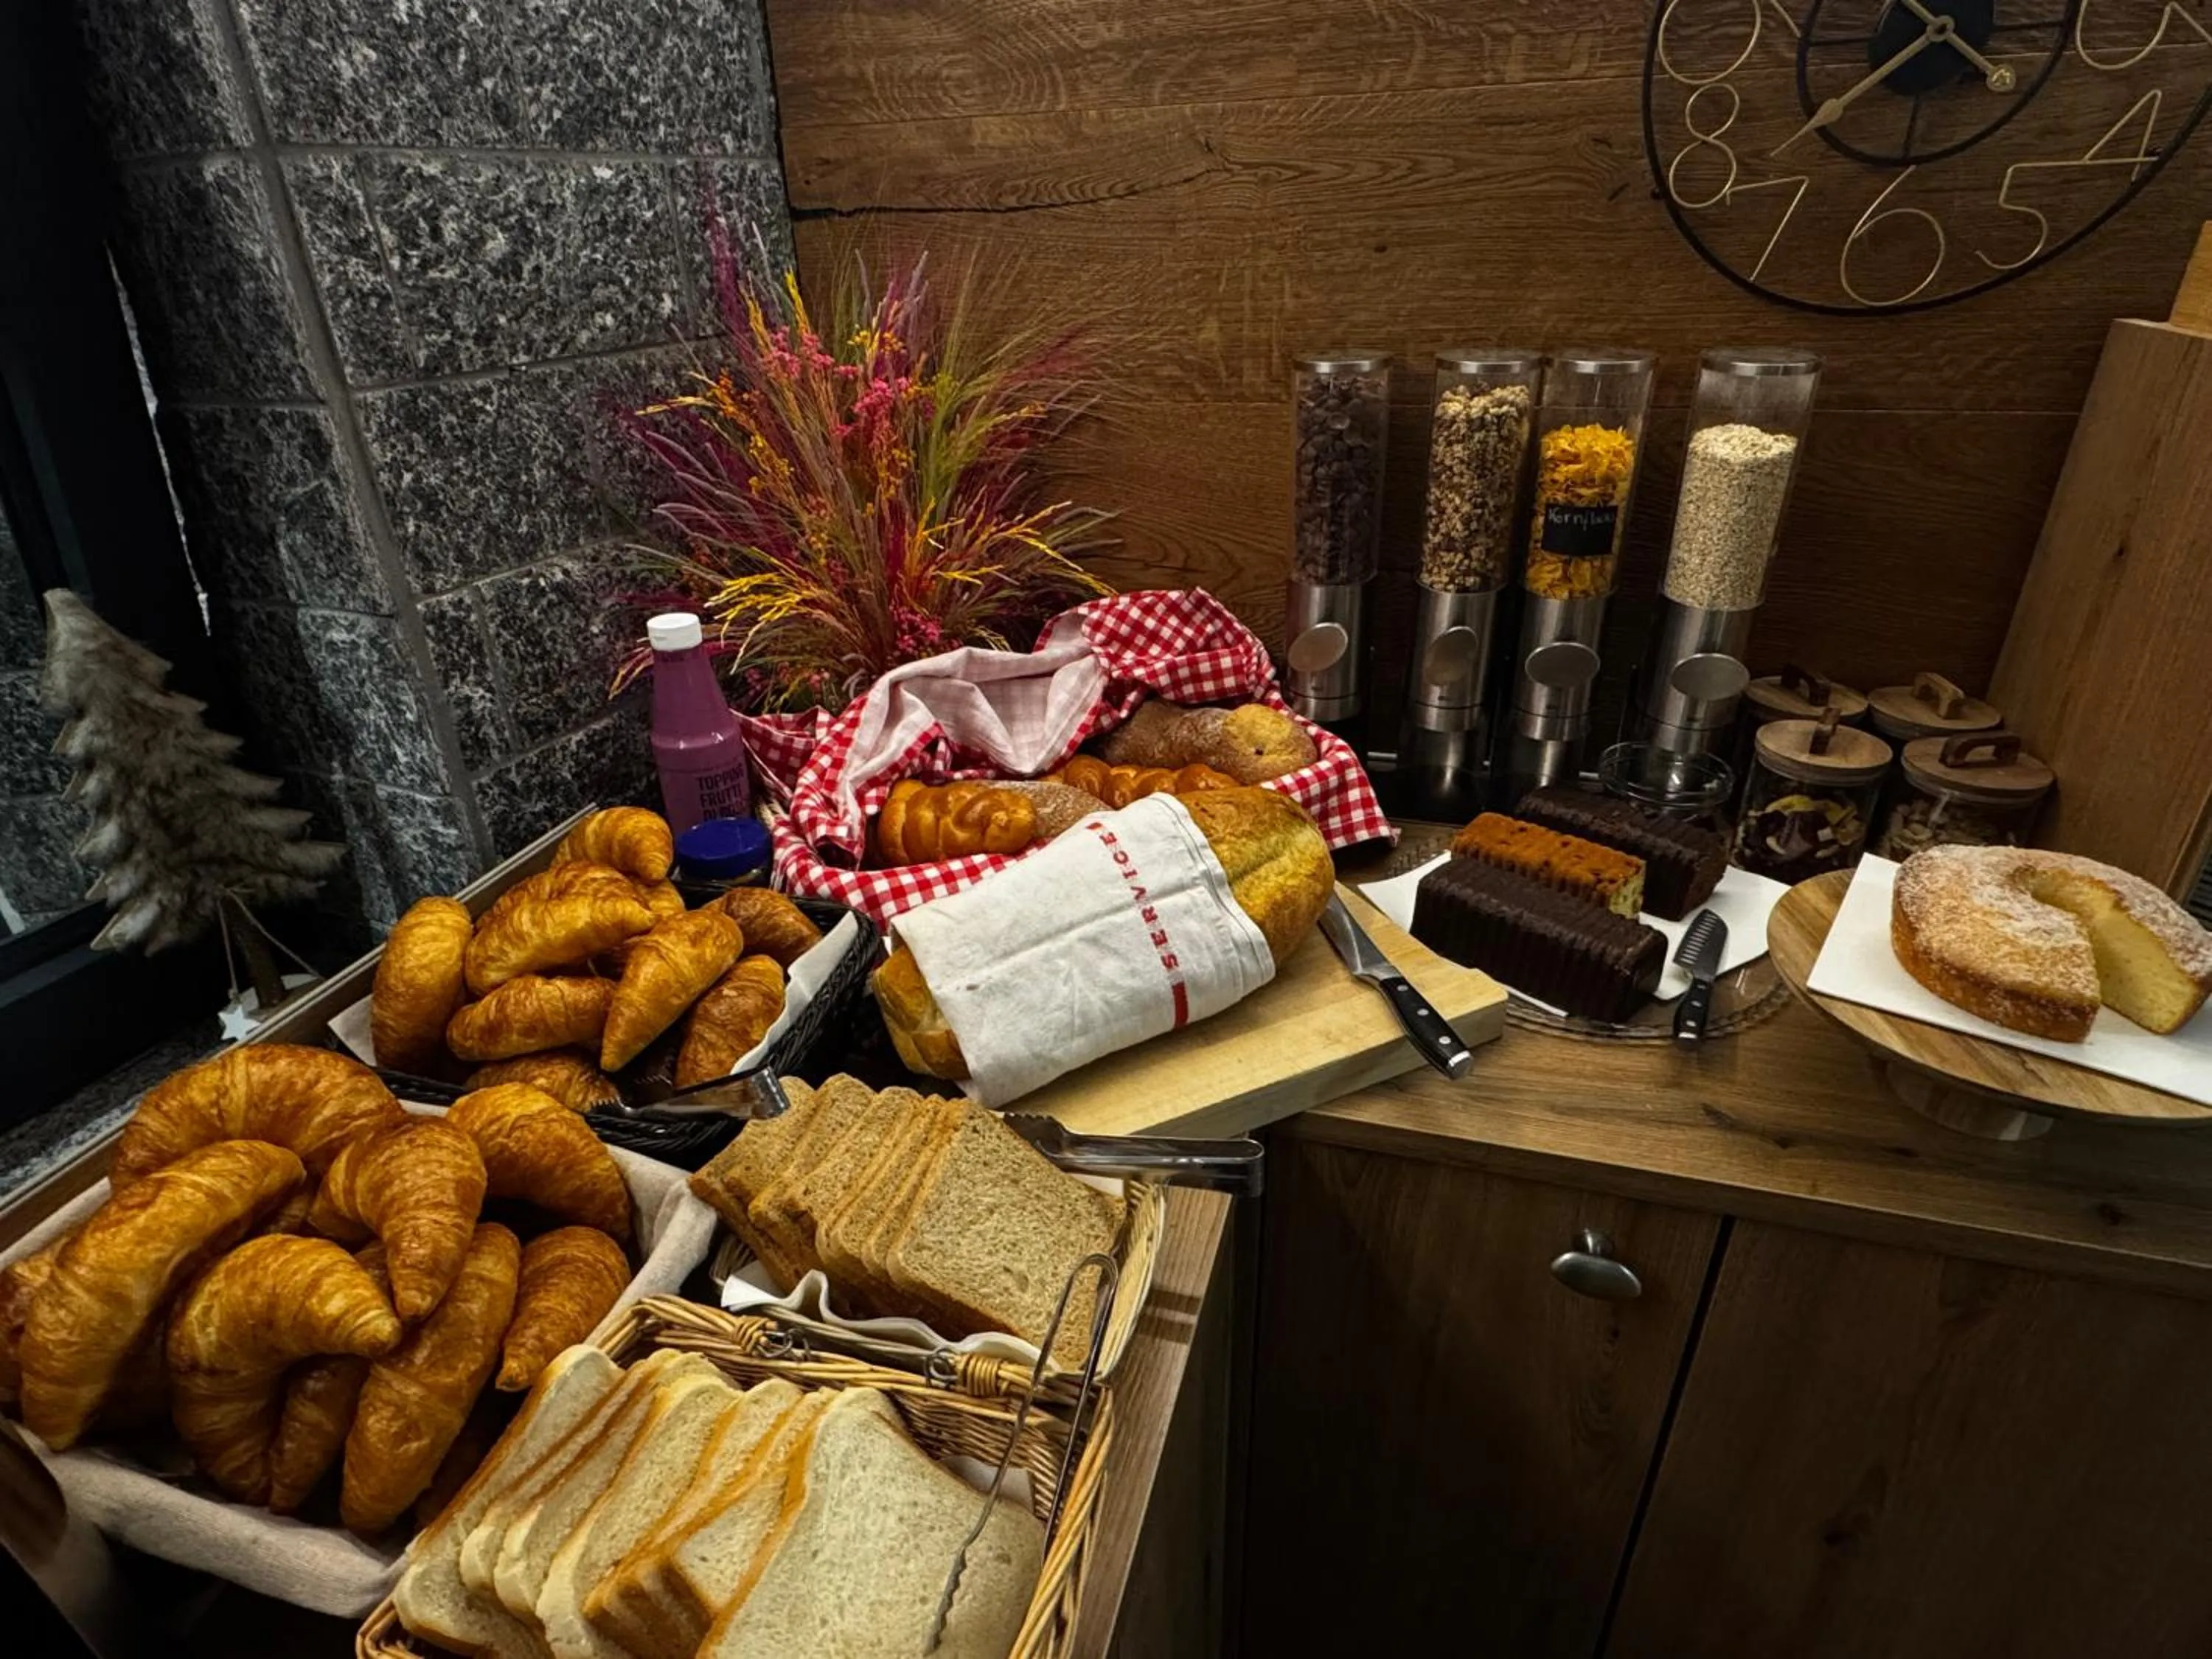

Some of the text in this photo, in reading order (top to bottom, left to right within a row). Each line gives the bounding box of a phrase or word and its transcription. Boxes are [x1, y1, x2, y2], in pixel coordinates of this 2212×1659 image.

[1669, 83, 1739, 207] 8
[2083, 89, 2160, 183] 4
[1724, 176, 1809, 281] 7
[1840, 164, 1944, 307] 6
[1974, 162, 2084, 270] 5
[700, 783, 742, 807] FRUTTI
[1099, 831, 1179, 973] SERVICE
